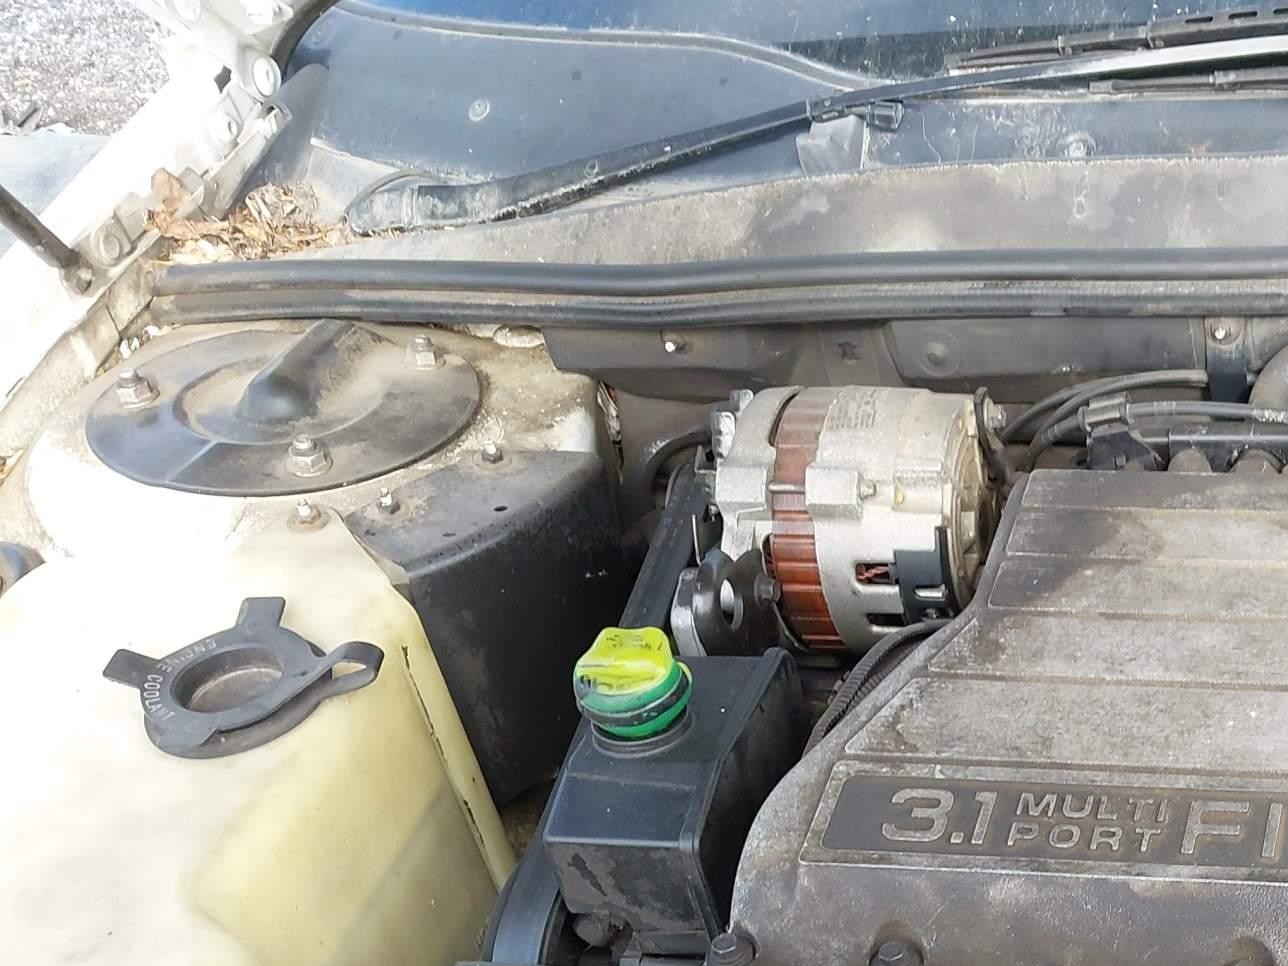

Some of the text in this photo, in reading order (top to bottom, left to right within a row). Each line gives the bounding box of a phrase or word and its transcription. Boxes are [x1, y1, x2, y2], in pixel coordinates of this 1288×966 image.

[143, 674, 176, 720] COOLANT
[881, 786, 1285, 859] 3.1 MULTI PORT FI
